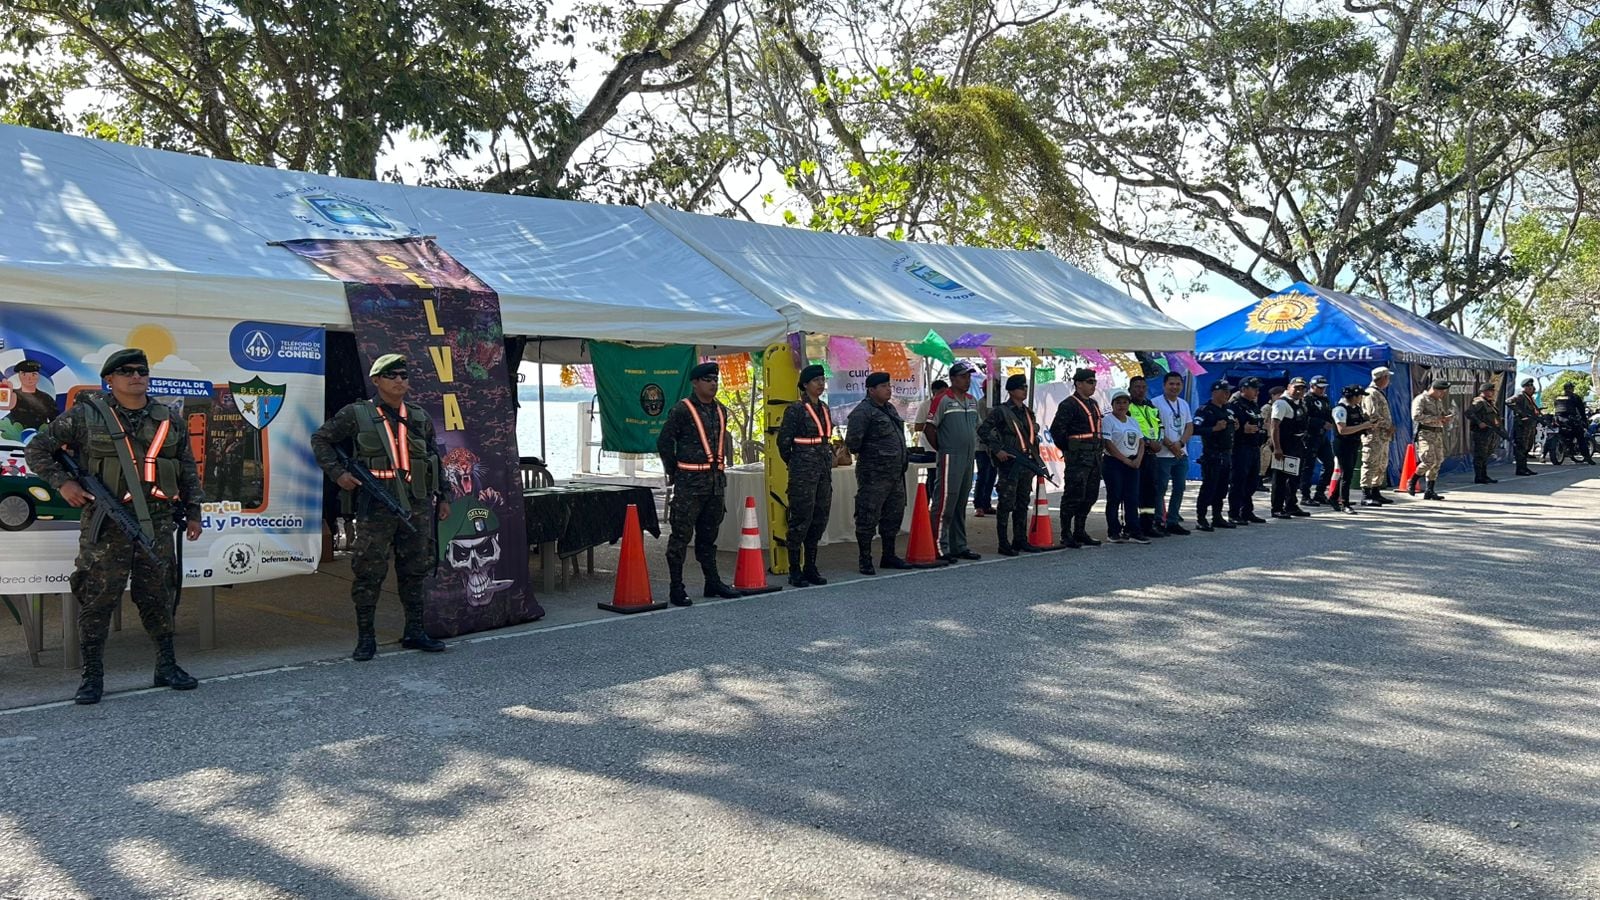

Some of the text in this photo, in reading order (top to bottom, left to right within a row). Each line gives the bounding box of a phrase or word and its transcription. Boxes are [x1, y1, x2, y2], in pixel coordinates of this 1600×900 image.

[376, 255, 465, 430] SELVA
[249, 345, 268, 357] 119
[278, 350, 321, 360] CONRED
[1221, 349, 1317, 361] NACIONAL
[1323, 346, 1374, 361] CIVIL
[152, 380, 192, 388] ESPECIAL
[845, 383, 859, 391] en
[216, 519, 226, 531] y
[231, 515, 302, 528] Protección
[28, 574, 42, 584] de
